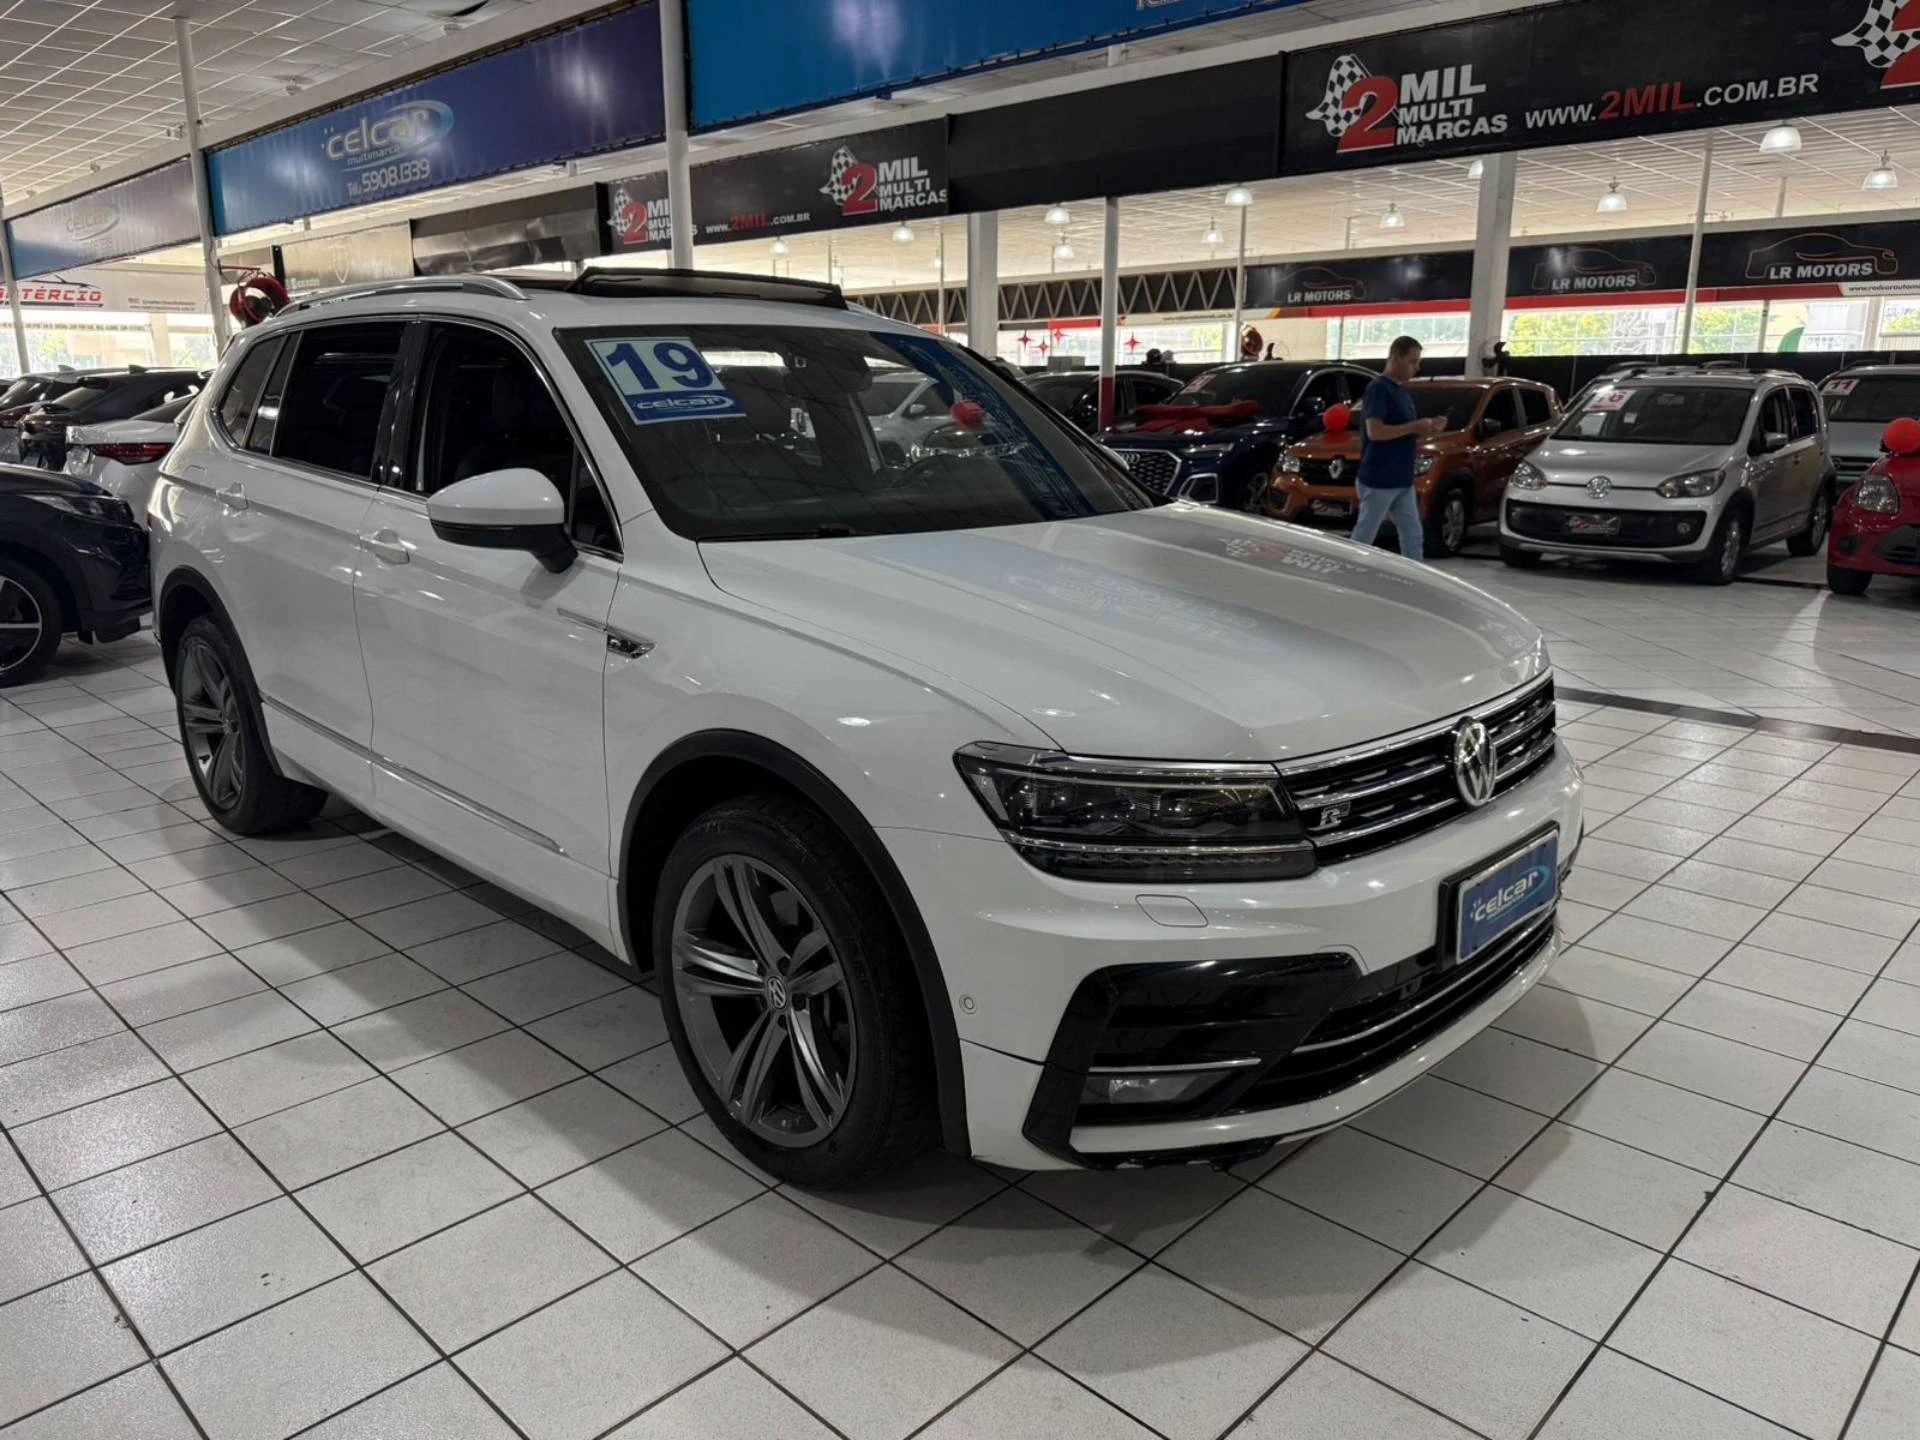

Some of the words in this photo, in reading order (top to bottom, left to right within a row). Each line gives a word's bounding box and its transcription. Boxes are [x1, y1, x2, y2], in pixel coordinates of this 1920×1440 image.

[1337, 76, 1397, 153] 2
[1401, 64, 1486, 104] MIL
[1398, 98, 1472, 125] MULTI
[1396, 114, 1508, 146] MARCAS
[878, 157, 928, 183] MIL
[879, 178, 930, 197] MULTI
[647, 199, 670, 219] MI
[879, 189, 948, 212] MARCAS
[1552, 278, 1570, 291] LR
[1574, 274, 1636, 290] MOTORS
[1769, 266, 1791, 280] LR
[1796, 262, 1873, 279] MOTORS
[1287, 291, 1301, 303] LR
[1304, 289, 1352, 302] MOTORS
[606, 342, 714, 390] 19
[637, 397, 722, 410] celcar
[1474, 870, 1539, 922] celcar
